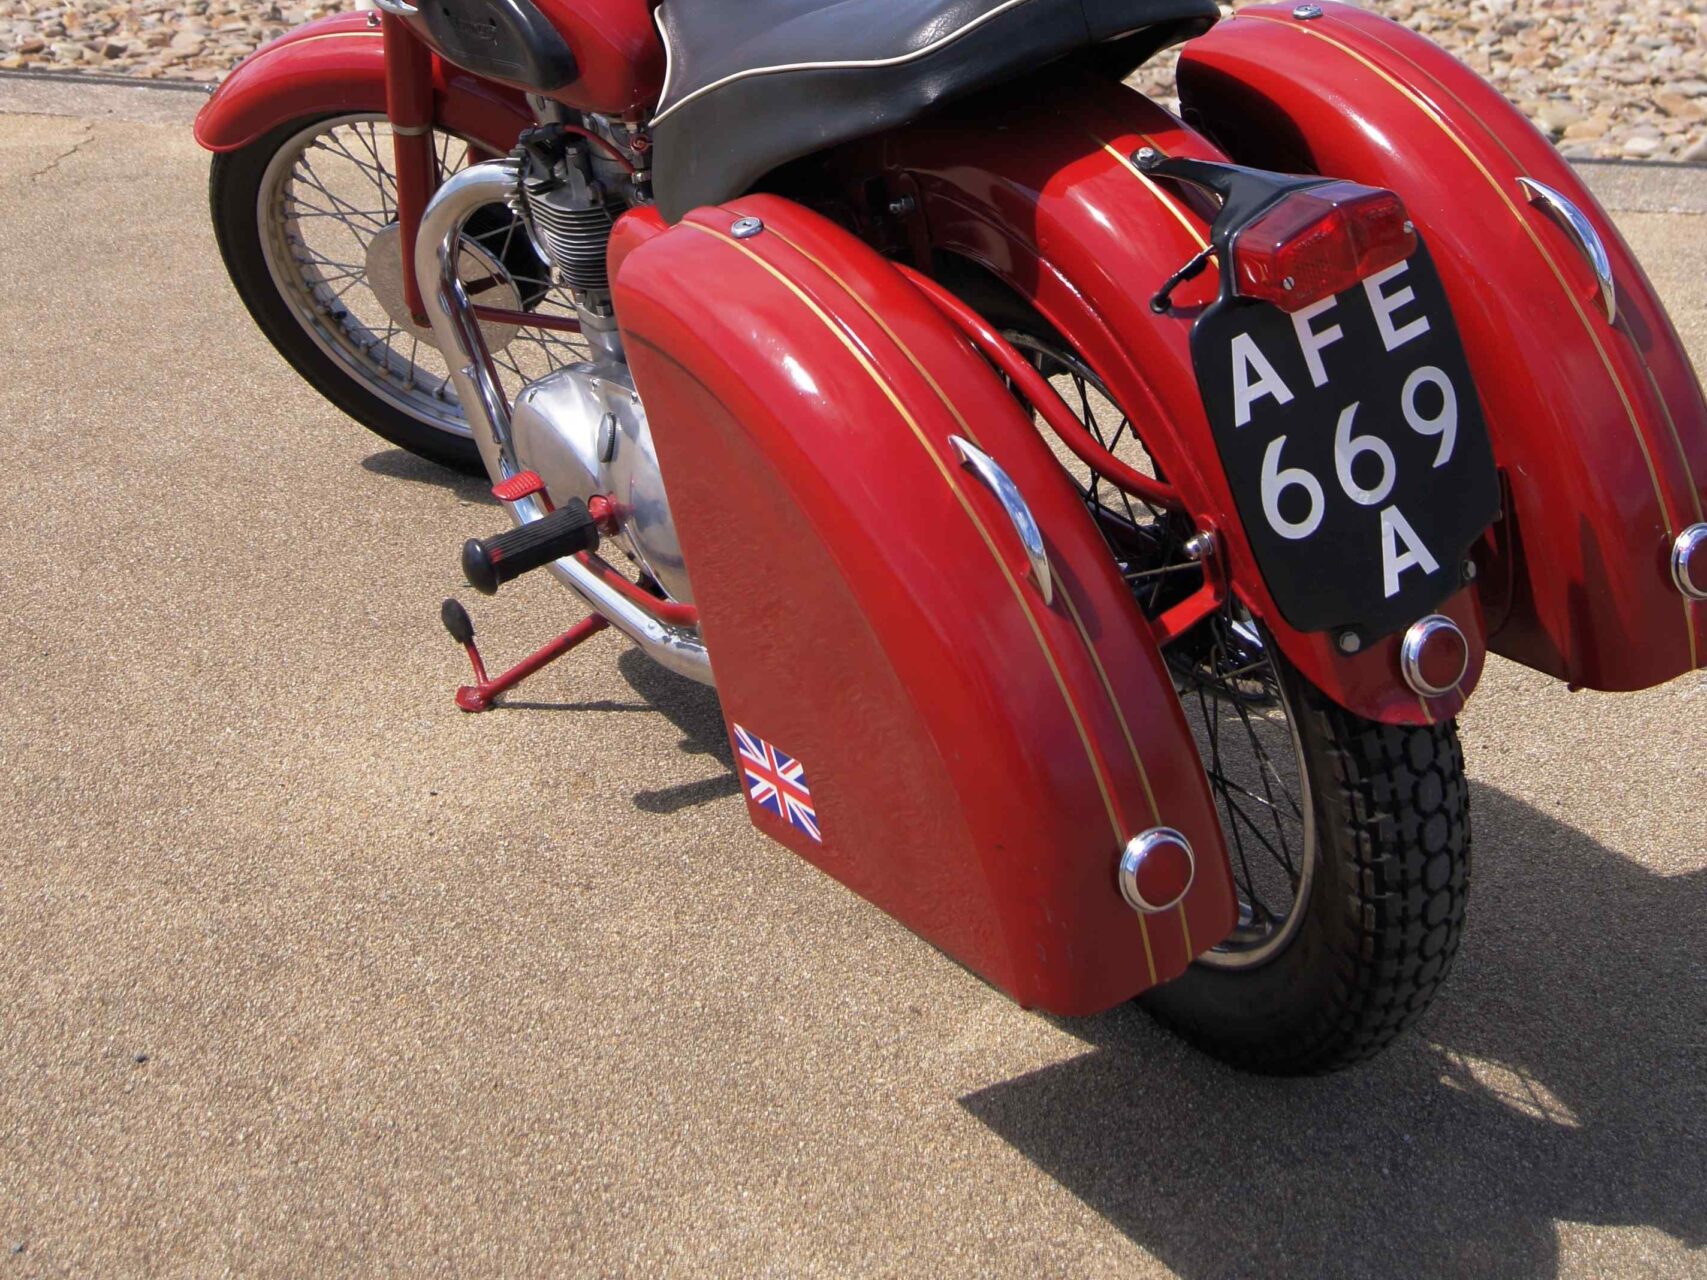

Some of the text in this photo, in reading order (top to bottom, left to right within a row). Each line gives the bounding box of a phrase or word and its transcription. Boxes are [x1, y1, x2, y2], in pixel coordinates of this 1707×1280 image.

[1231, 259, 1430, 428] AFE
[1260, 365, 1458, 540] 669
[1380, 504, 1440, 599] A
